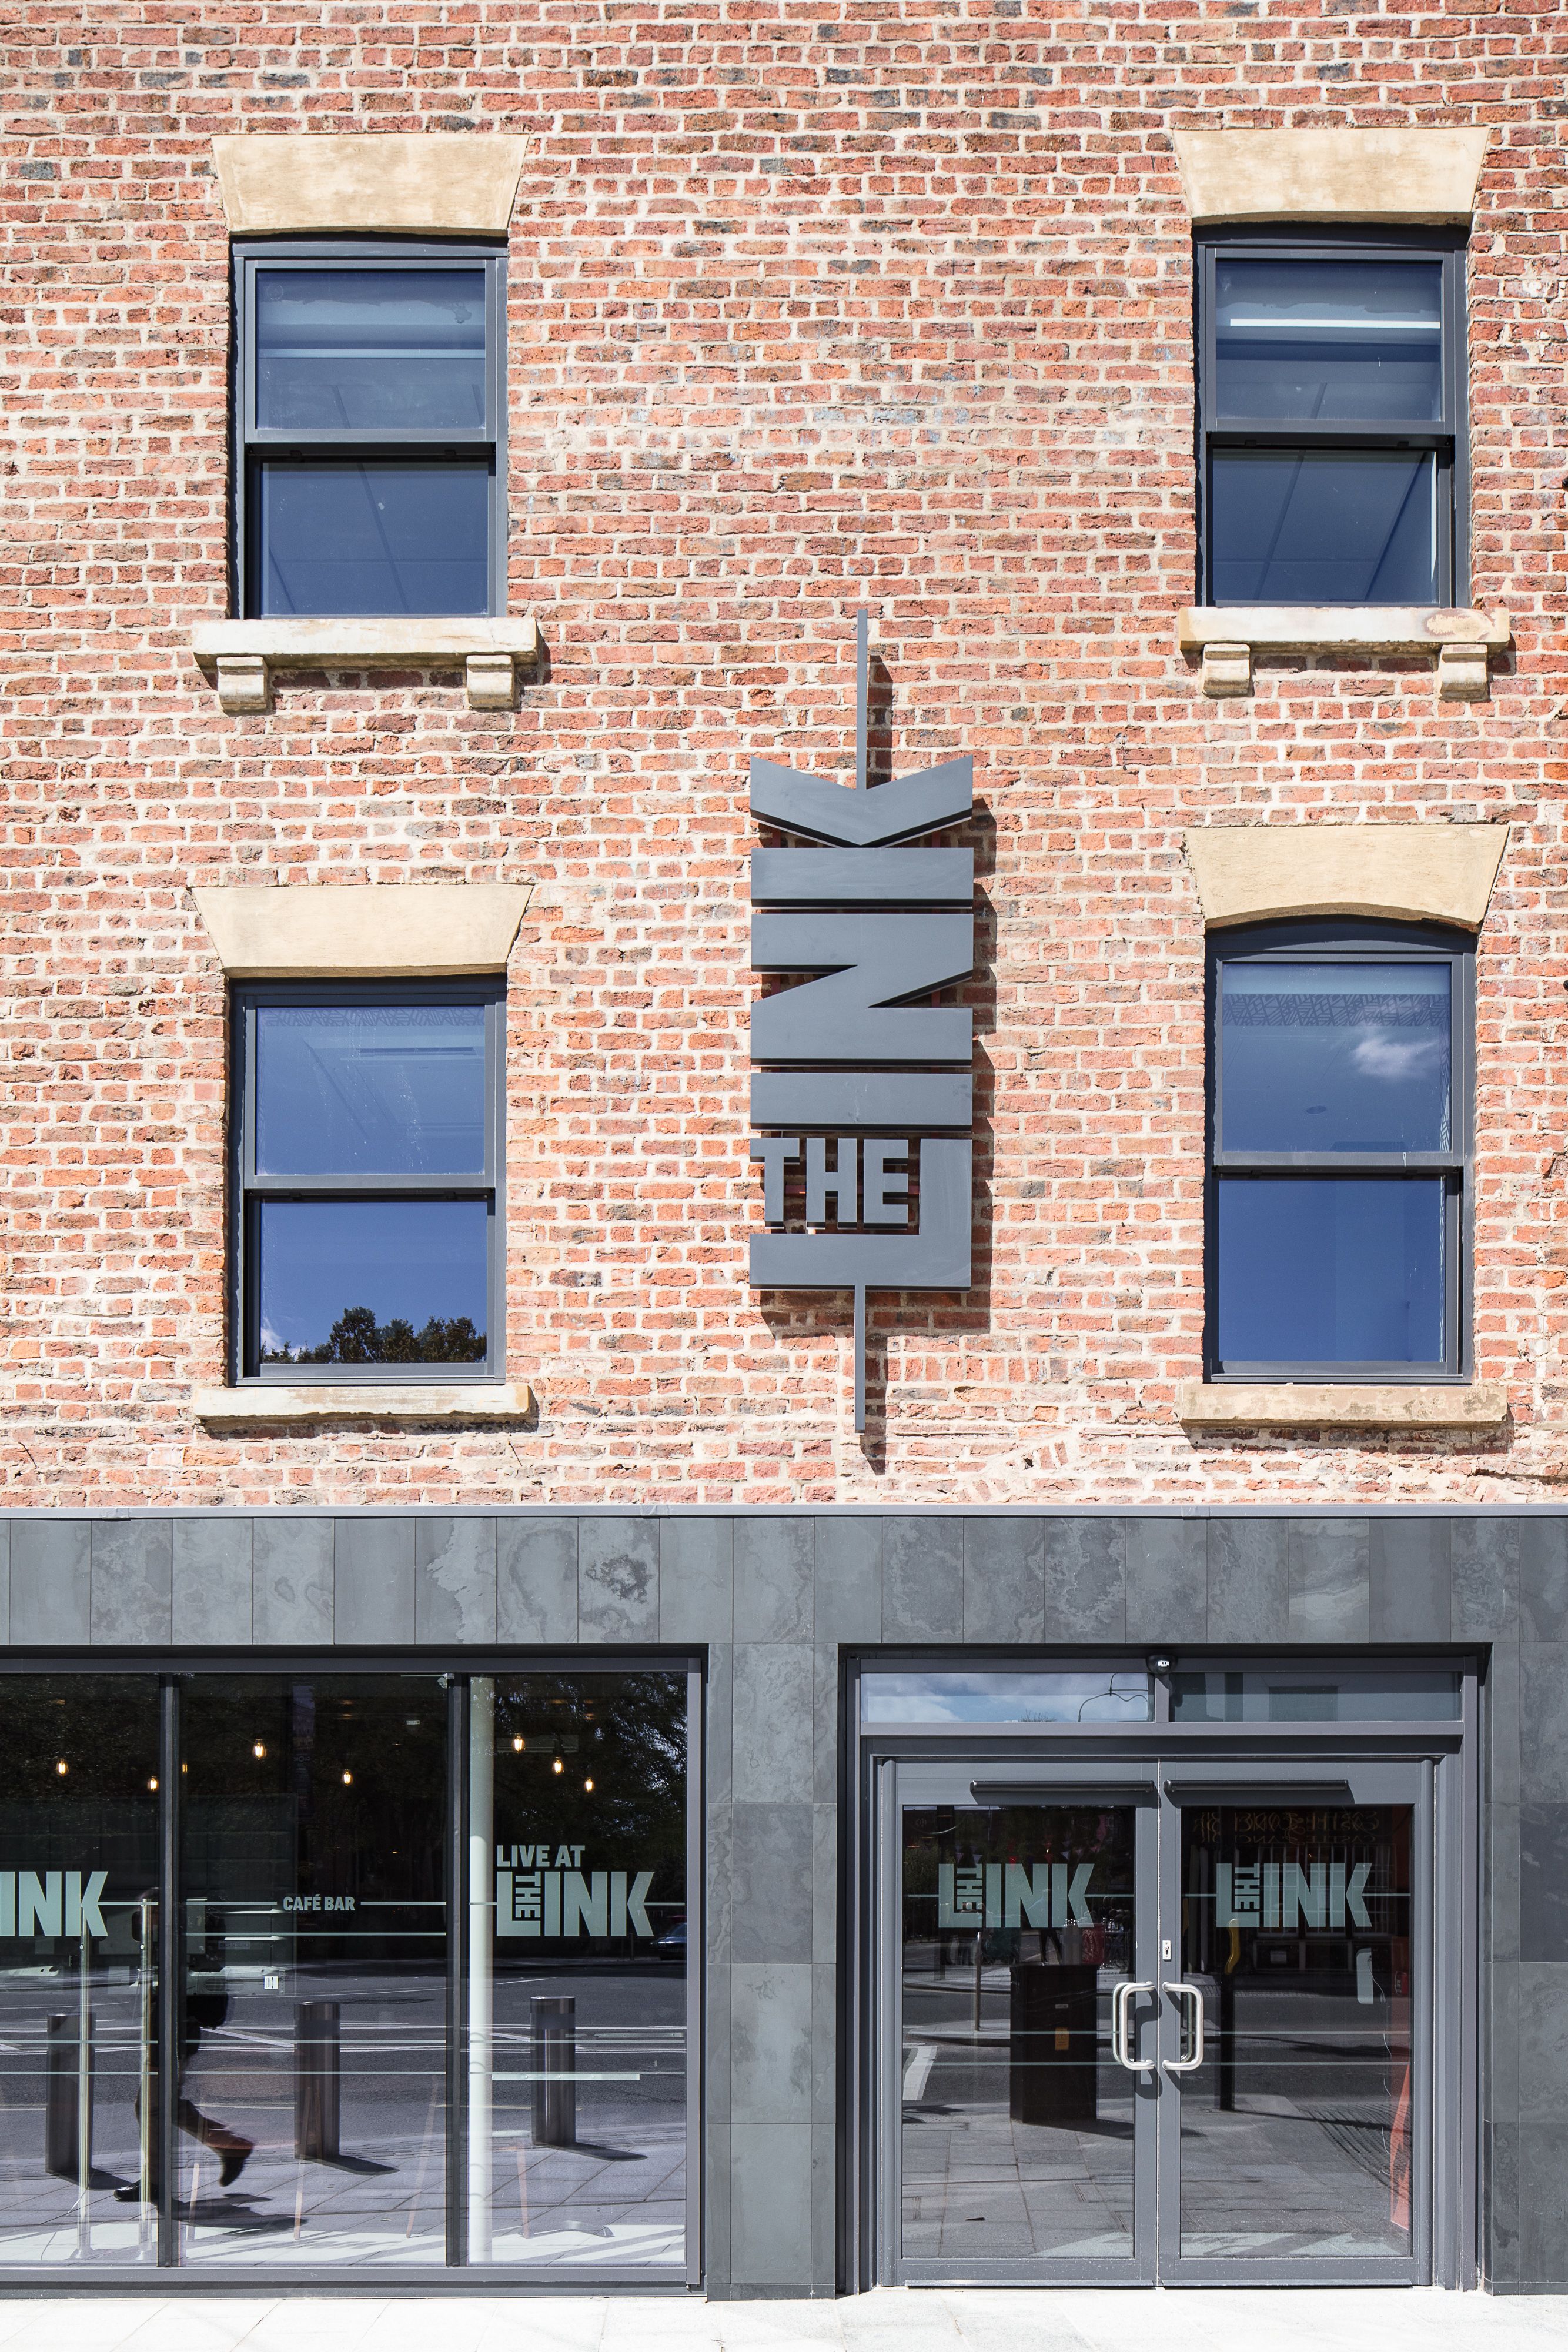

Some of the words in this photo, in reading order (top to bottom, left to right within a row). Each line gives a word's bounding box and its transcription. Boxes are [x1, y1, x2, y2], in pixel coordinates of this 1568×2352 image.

[750, 755, 974, 1291] LINK
[750, 1138, 908, 1229] THE
[497, 1845, 550, 1867] LIVE
[554, 1845, 585, 1867] AT
[283, 1893, 322, 1911] CAFÉ
[324, 1896, 355, 1911] BAR
[496, 1871, 654, 1936] LINK
[515, 1872, 541, 1918] THE
[938, 1863, 1095, 1929] LINK
[957, 1864, 982, 1910] THE
[1216, 1863, 1372, 1927] LINK
[1235, 1863, 1260, 1910] THE
